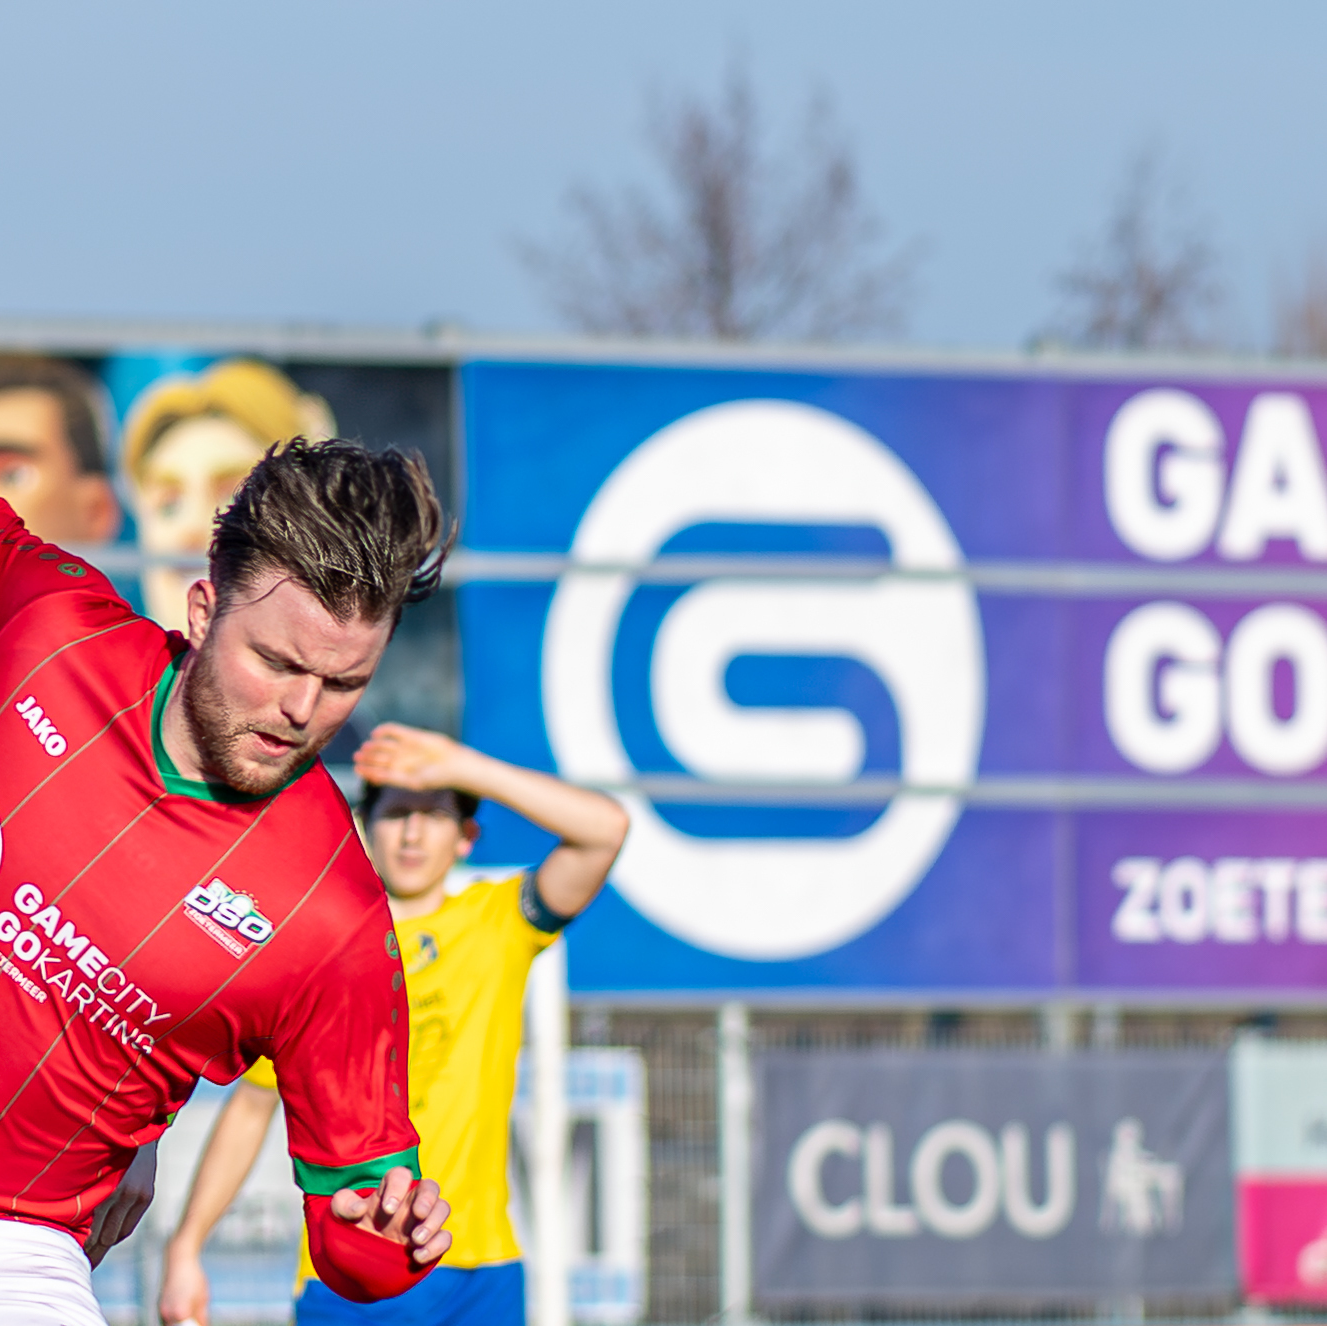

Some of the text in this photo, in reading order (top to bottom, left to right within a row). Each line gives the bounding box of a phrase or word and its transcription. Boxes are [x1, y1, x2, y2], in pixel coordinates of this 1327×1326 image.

[1104, 388, 1327, 562] GA
[15, 696, 68, 757] JAKO
[1104, 601, 1327, 774] GO
[14, 884, 172, 1026] GAMECITY
[184, 885, 273, 944] DSO
[788, 1119, 1075, 1239] CLOU
